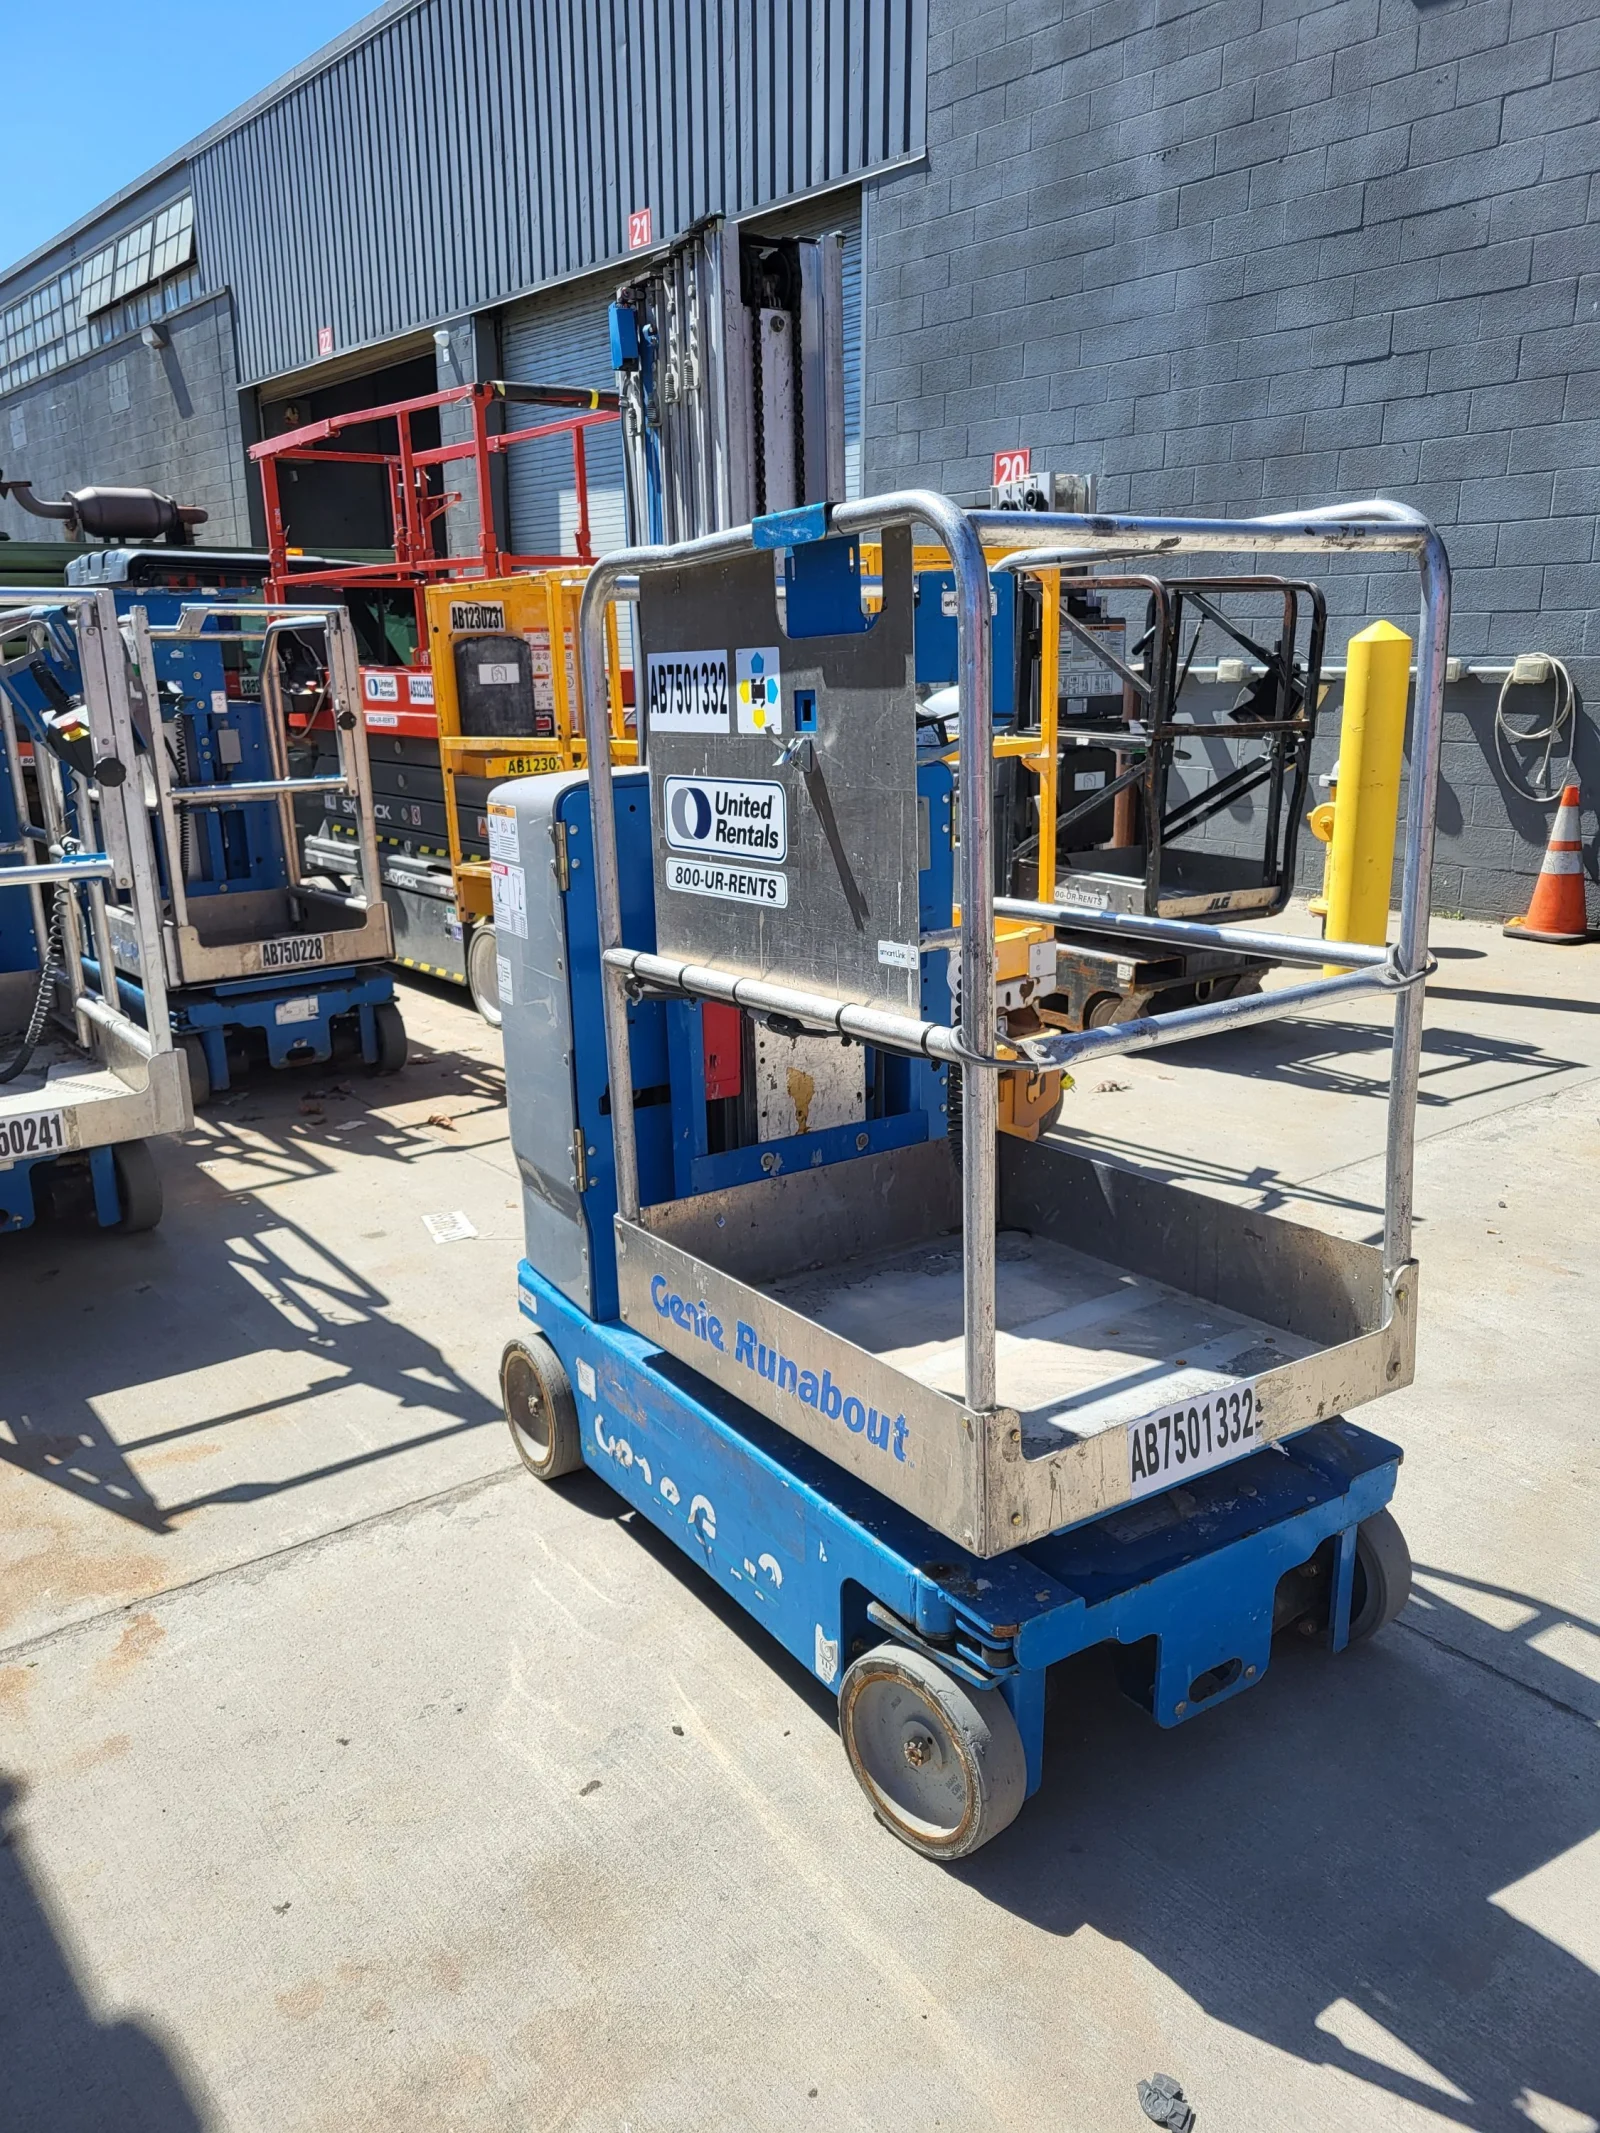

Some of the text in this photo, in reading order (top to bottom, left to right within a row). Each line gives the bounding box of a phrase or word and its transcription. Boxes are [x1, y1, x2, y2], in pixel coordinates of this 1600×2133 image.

[632, 214, 648, 246] 21
[320, 331, 331, 352] 22
[999, 454, 1025, 484] 20
[451, 606, 504, 630] AB1230231
[650, 661, 728, 715] AB7501332
[341, 799, 393, 820] SKCK
[715, 790, 773, 820] United
[715, 818, 779, 849] Rentals
[675, 866, 777, 899] 800-UR-RENTS
[1054, 890, 1103, 906] 00-UR-RENTS
[1207, 896, 1231, 911] JLG
[262, 937, 324, 967] AB750228
[650, 1274, 725, 1352] Genie
[735, 1320, 910, 1463] Runabout
[1131, 1388, 1254, 1484] AB7501332
